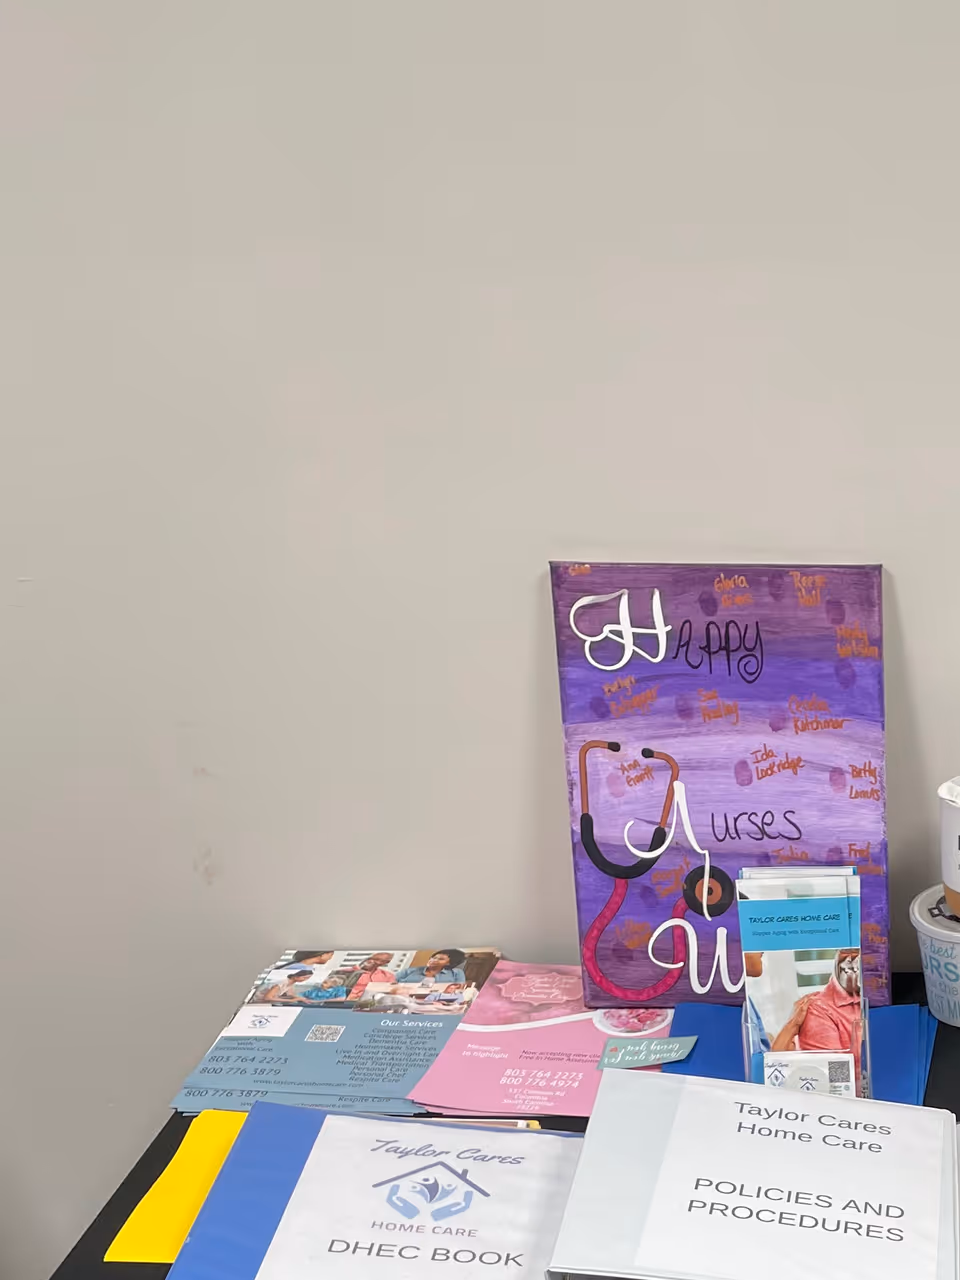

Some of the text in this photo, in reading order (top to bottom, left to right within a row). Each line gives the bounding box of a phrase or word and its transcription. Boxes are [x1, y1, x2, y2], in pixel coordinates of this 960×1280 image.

[751, 744, 777, 764] Ida
[402, 1020, 443, 1028] Services
[258, 1057, 289, 1065] 2273
[226, 1067, 247, 1075] 776
[250, 1068, 281, 1076] 3879
[504, 1068, 526, 1076] 803
[530, 1070, 551, 1078] 764
[500, 1077, 579, 1088] 800 776 4974
[184, 1089, 268, 1098] 800 776 3879
[734, 1101, 892, 1136] Taylor Cares
[736, 1121, 883, 1154] Home Care
[370, 1139, 526, 1165] Taylor Cares
[694, 1178, 905, 1219] POLICIES AND
[370, 1221, 478, 1238] HOME CARE
[687, 1199, 904, 1242] PROCEDURES
[327, 1239, 524, 1267] DHEC BOOK
